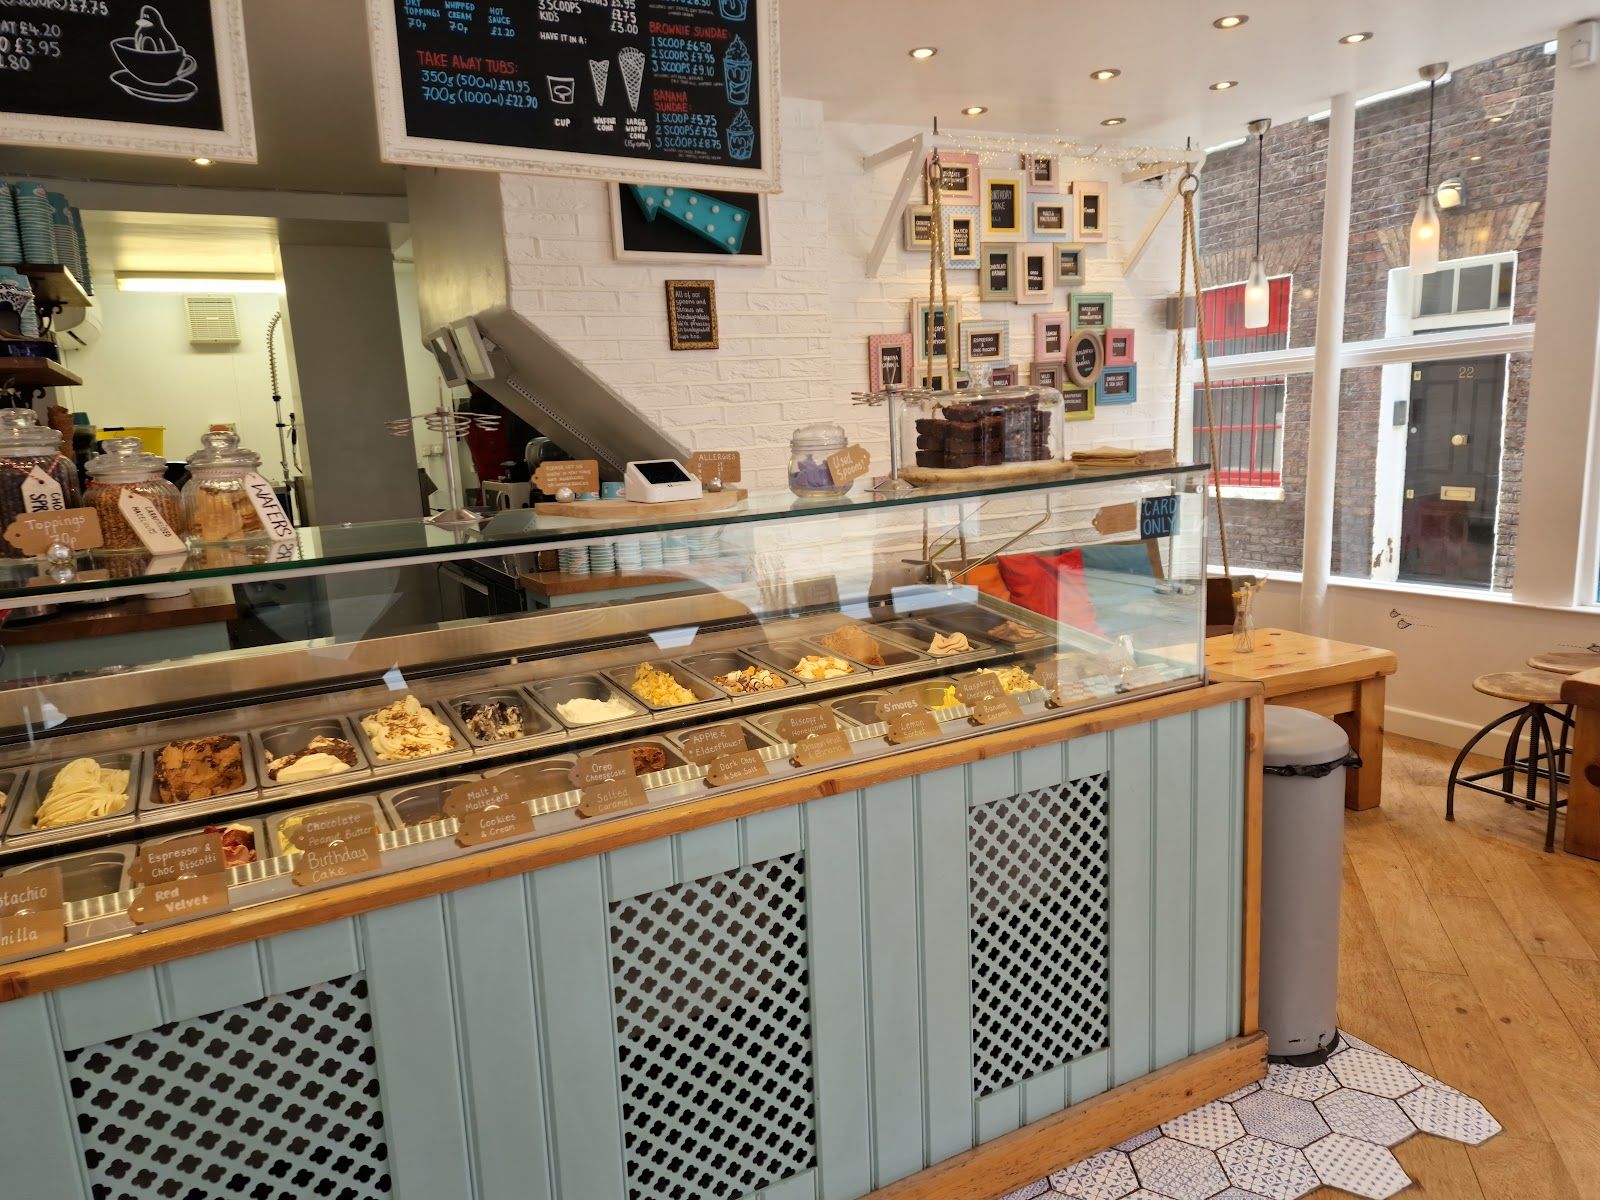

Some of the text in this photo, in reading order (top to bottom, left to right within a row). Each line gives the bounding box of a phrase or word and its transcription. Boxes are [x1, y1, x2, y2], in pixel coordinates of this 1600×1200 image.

[404, 6, 440, 18] TOPPINGS
[445, 0, 476, 11] WHIPPED
[490, 7, 504, 16] HOT
[547, 0, 582, 14] SCOOPS
[448, 10, 472, 21] CREAM
[488, 16, 511, 26] SAUCE
[539, 10, 639, 35] KID'S £3.00
[20, 20, 61, 37] £4.20
[408, 18, 427, 30] 70p
[448, 20, 469, 34] 70p
[648, 20, 690, 36] BROWNIE
[490, 26, 516, 38] £1.20
[539, 31, 559, 41] HAVE
[560, 33, 568, 42] IT
[569, 35, 577, 44] IN
[15, 37, 60, 58] £3.95
[651, 36, 712, 52] 1 SCOOP £6.50
[416, 50, 449, 67] TAKE
[452, 54, 483, 72] AWAY
[651, 49, 716, 64] 2 SCOOPS £7.95
[652, 60, 715, 77] 3 SCOOPS £9.10
[421, 69, 454, 88] 350g
[499, 78, 531, 94] £11.95
[422, 86, 457, 104] 700g
[504, 94, 539, 110] £22.90
[653, 89, 688, 102] BANANA
[554, 118, 571, 127] CUP
[626, 118, 646, 126] LARGE
[656, 114, 718, 126] 1 SCOOP £5.75
[655, 124, 718, 138] 2 SCOOPS £7.25
[655, 136, 722, 150] 3 SCOOPS £8.75
[684, 290, 691, 299] of
[1458, 366, 1474, 378] 22
[833, 452, 853, 468] Used
[250, 483, 292, 539] WAFERS
[1144, 498, 1177, 516] CARD
[24, 516, 86, 535] Toppings
[1143, 516, 1177, 536] ONLY
[883, 699, 919, 713] S'mores
[900, 720, 925, 730] Lemon
[693, 730, 718, 744] Apple
[591, 762, 614, 774] Oreo
[719, 756, 757, 772] Dark Choc
[465, 792, 510, 812] Maltesers
[467, 788, 491, 801] Malt
[596, 788, 630, 802] Salted
[306, 814, 362, 833] Chocolate
[479, 812, 518, 828] Cookies
[480, 823, 516, 838] & Cream
[148, 842, 212, 866] Espresso &
[308, 846, 369, 870] Birthday
[151, 852, 218, 879] Choc Biscotti
[312, 866, 348, 883] Cake
[155, 886, 180, 902] Red
[164, 894, 210, 914] Velvet
